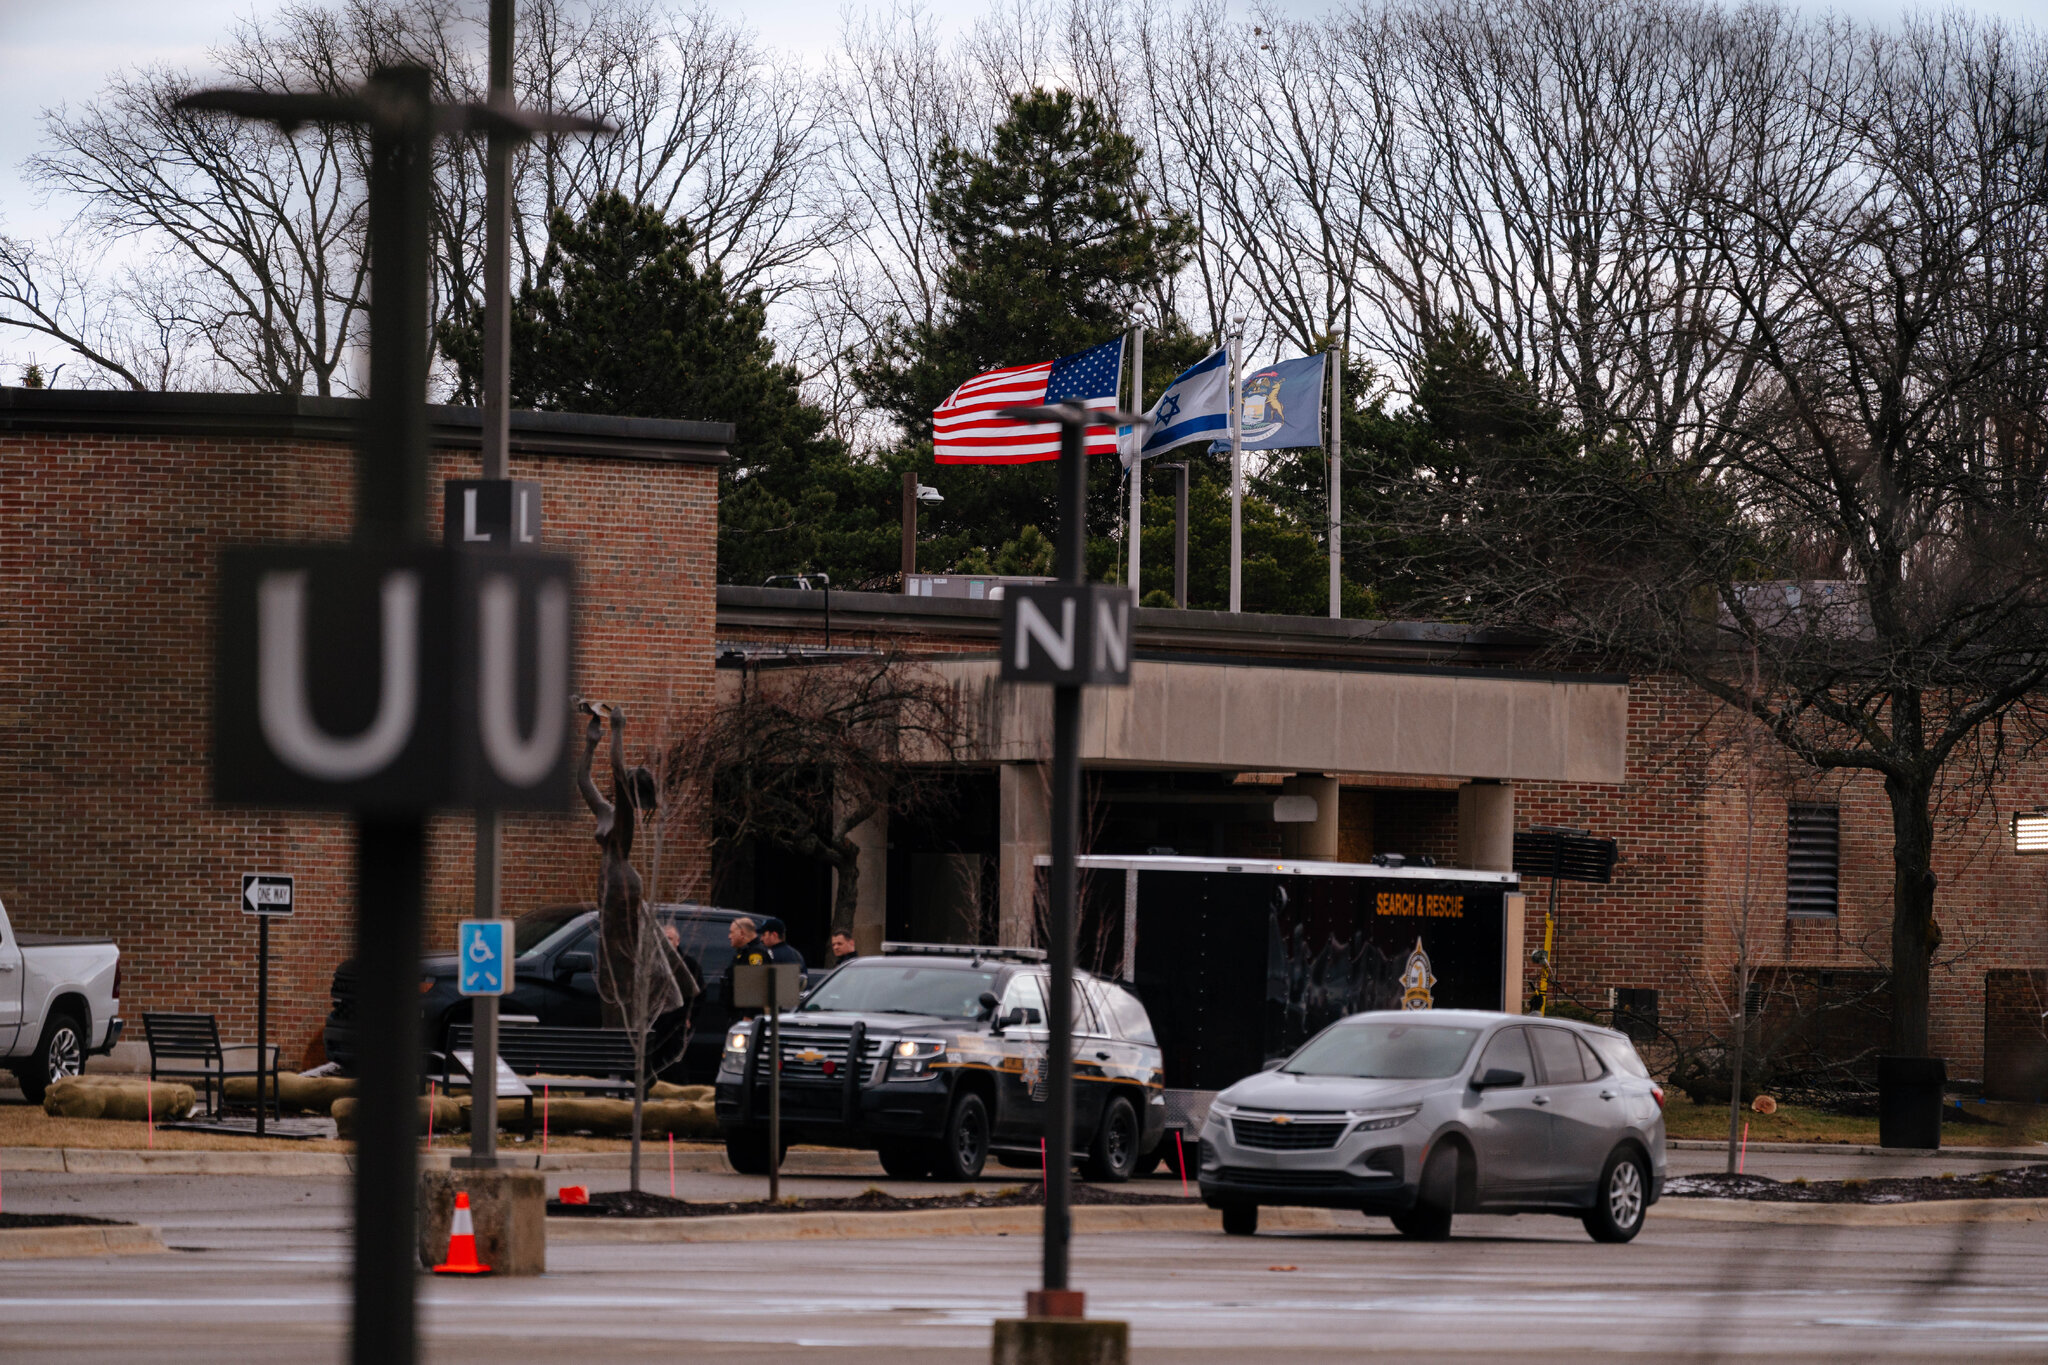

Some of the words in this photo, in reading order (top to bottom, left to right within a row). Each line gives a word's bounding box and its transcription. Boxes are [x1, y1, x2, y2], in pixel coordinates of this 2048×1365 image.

[463, 488, 491, 542] L
[520, 489, 534, 543] L
[1014, 596, 1076, 671] N
[1096, 599, 1129, 673] N
[257, 571, 421, 782] U
[481, 574, 569, 788] U
[258, 887, 271, 902] ONE
[273, 888, 288, 902] WAY
[1376, 892, 1415, 917] SEARCH
[1416, 894, 1424, 917] &
[1426, 894, 1464, 918] RESCUE
